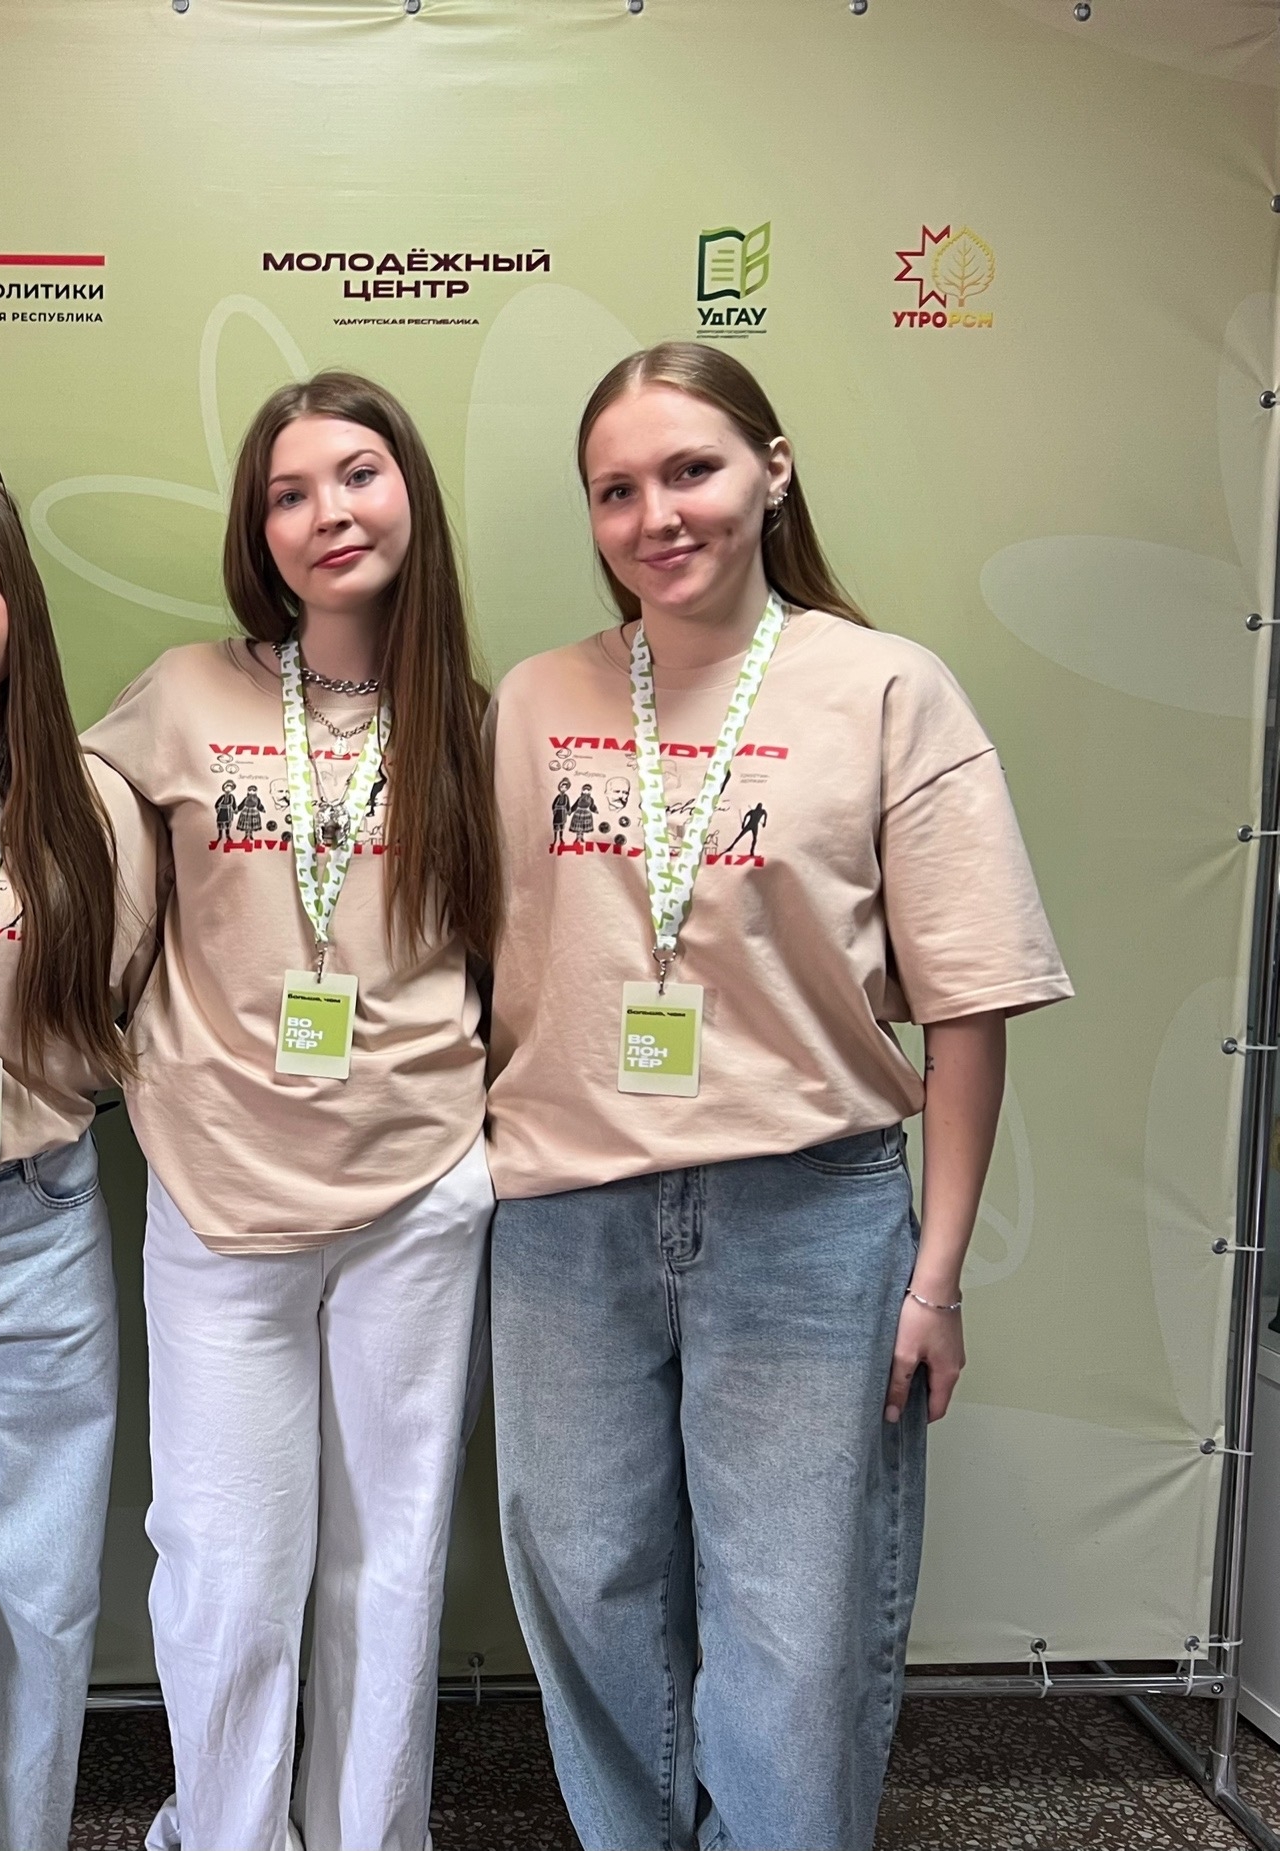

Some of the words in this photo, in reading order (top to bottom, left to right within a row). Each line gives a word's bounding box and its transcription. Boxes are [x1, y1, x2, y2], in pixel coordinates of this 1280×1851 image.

[262, 247, 552, 275] МОЛОДЁЖНЫЙ
[343, 279, 471, 302] ЦЕНТР
[11, 312, 105, 325] РЕСПУБЛИКА
[333, 318, 406, 326] УДМУРТСКАЯ
[407, 318, 481, 326] РЕСПУБЛИКА
[696, 307, 768, 326] УдГАУ
[287, 1016, 313, 1028] ВО
[285, 1027, 323, 1040] ЛОН
[627, 1034, 656, 1045] ВО
[285, 1036, 318, 1050] ТЁР
[627, 1045, 668, 1058] ЛОН
[626, 1055, 663, 1068] ТЁР
